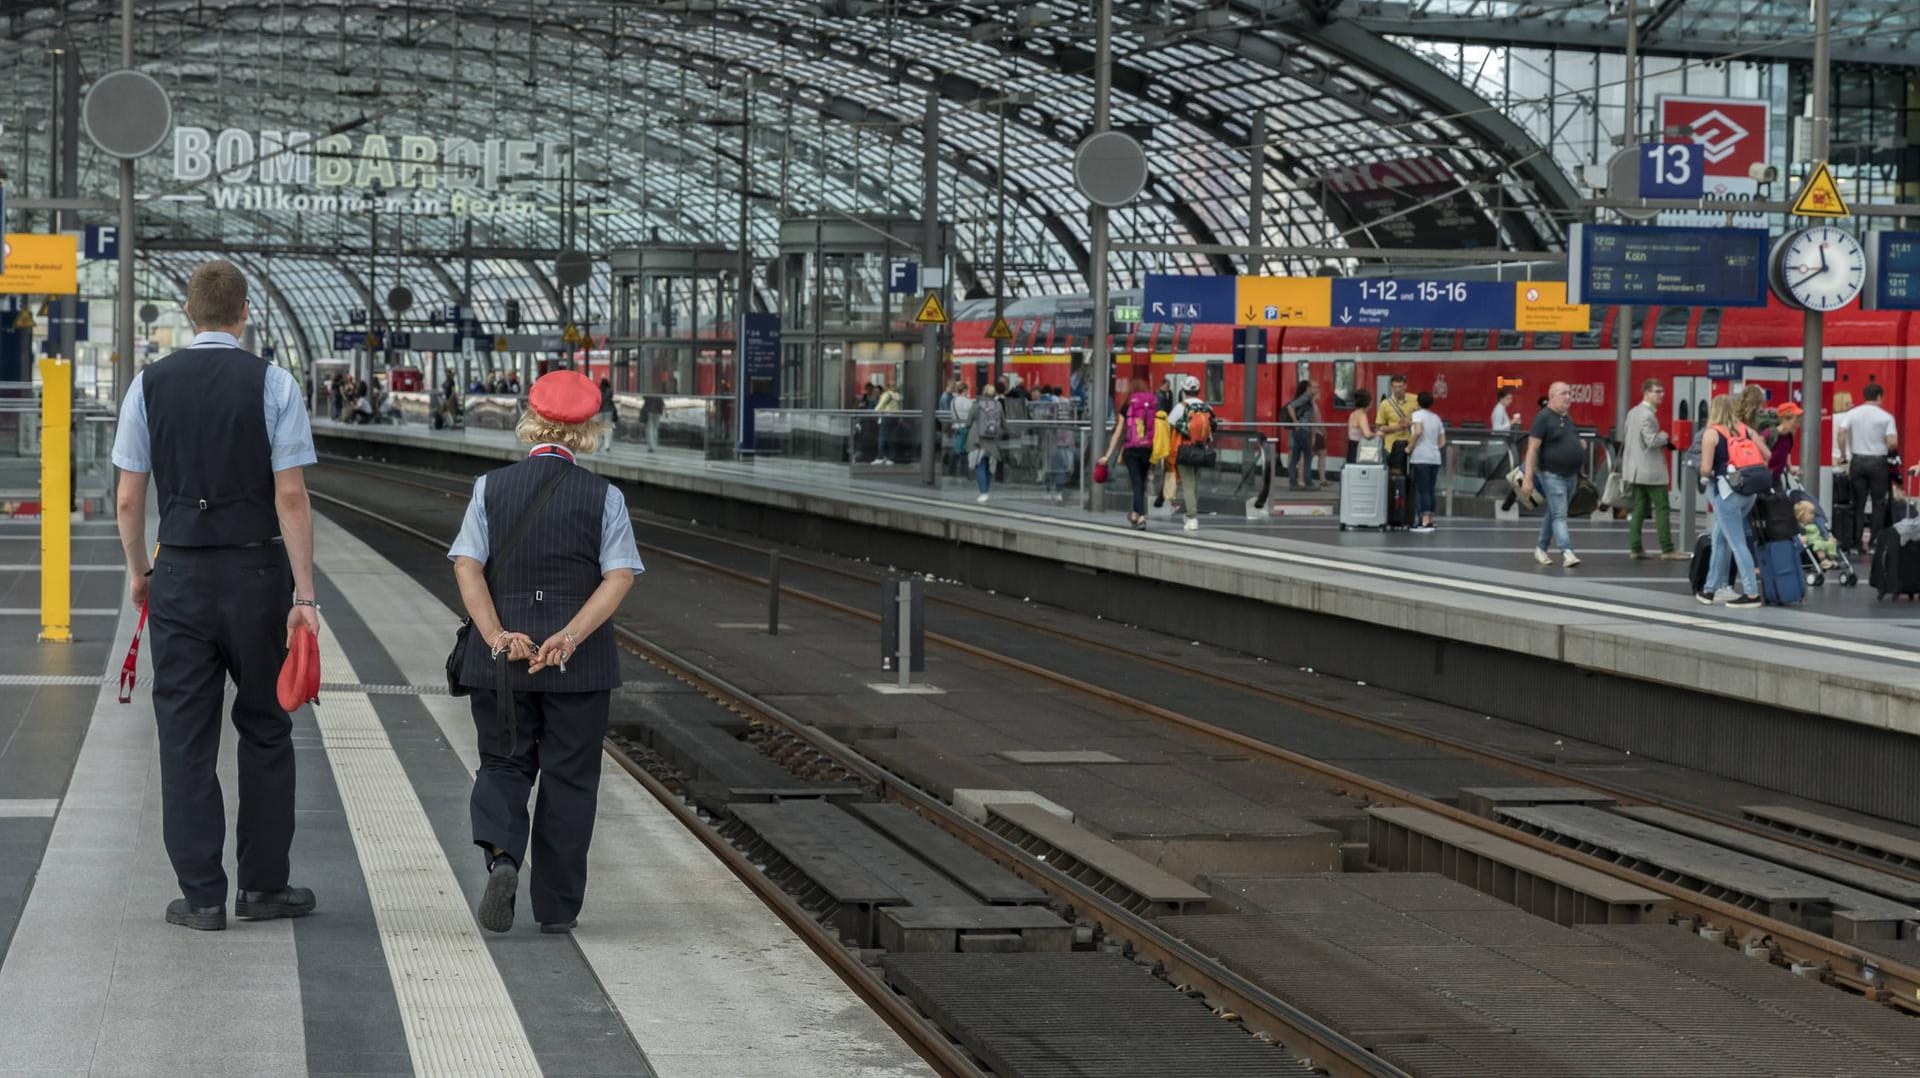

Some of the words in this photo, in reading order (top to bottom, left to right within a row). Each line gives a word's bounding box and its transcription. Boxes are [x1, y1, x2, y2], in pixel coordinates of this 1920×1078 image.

[174, 126, 578, 194] BOMBARDIER
[1648, 144, 1691, 185] 13
[413, 192, 440, 215] in
[451, 192, 537, 219] Berlin
[98, 226, 116, 253] F
[1625, 250, 1647, 261] Köln
[891, 263, 906, 287] F
[1359, 281, 1398, 300] 1-12
[1400, 292, 1415, 300] und
[1417, 282, 1467, 301] 15-16
[446, 304, 456, 319] E
[1359, 307, 1389, 317] Ausgang
[1568, 384, 1592, 404] EGIO
